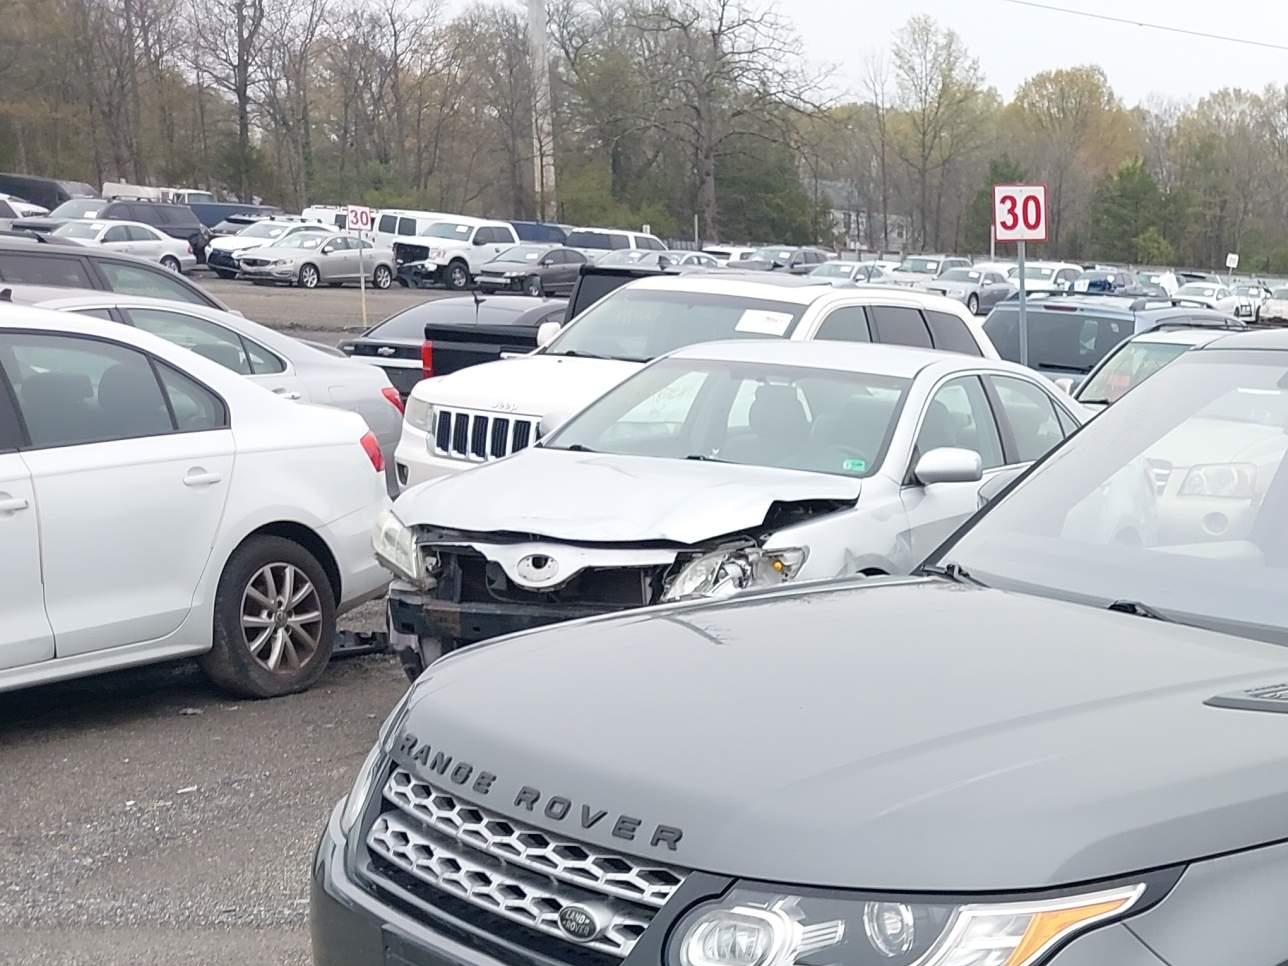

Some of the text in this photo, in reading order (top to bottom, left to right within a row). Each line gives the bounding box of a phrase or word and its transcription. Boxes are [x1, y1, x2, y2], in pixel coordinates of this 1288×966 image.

[350, 209, 369, 226] 30
[1000, 195, 1041, 231] 30
[400, 733, 683, 850] RANGE ROVER
[565, 909, 586, 925] LAND
[565, 920, 590, 937] ROVER
